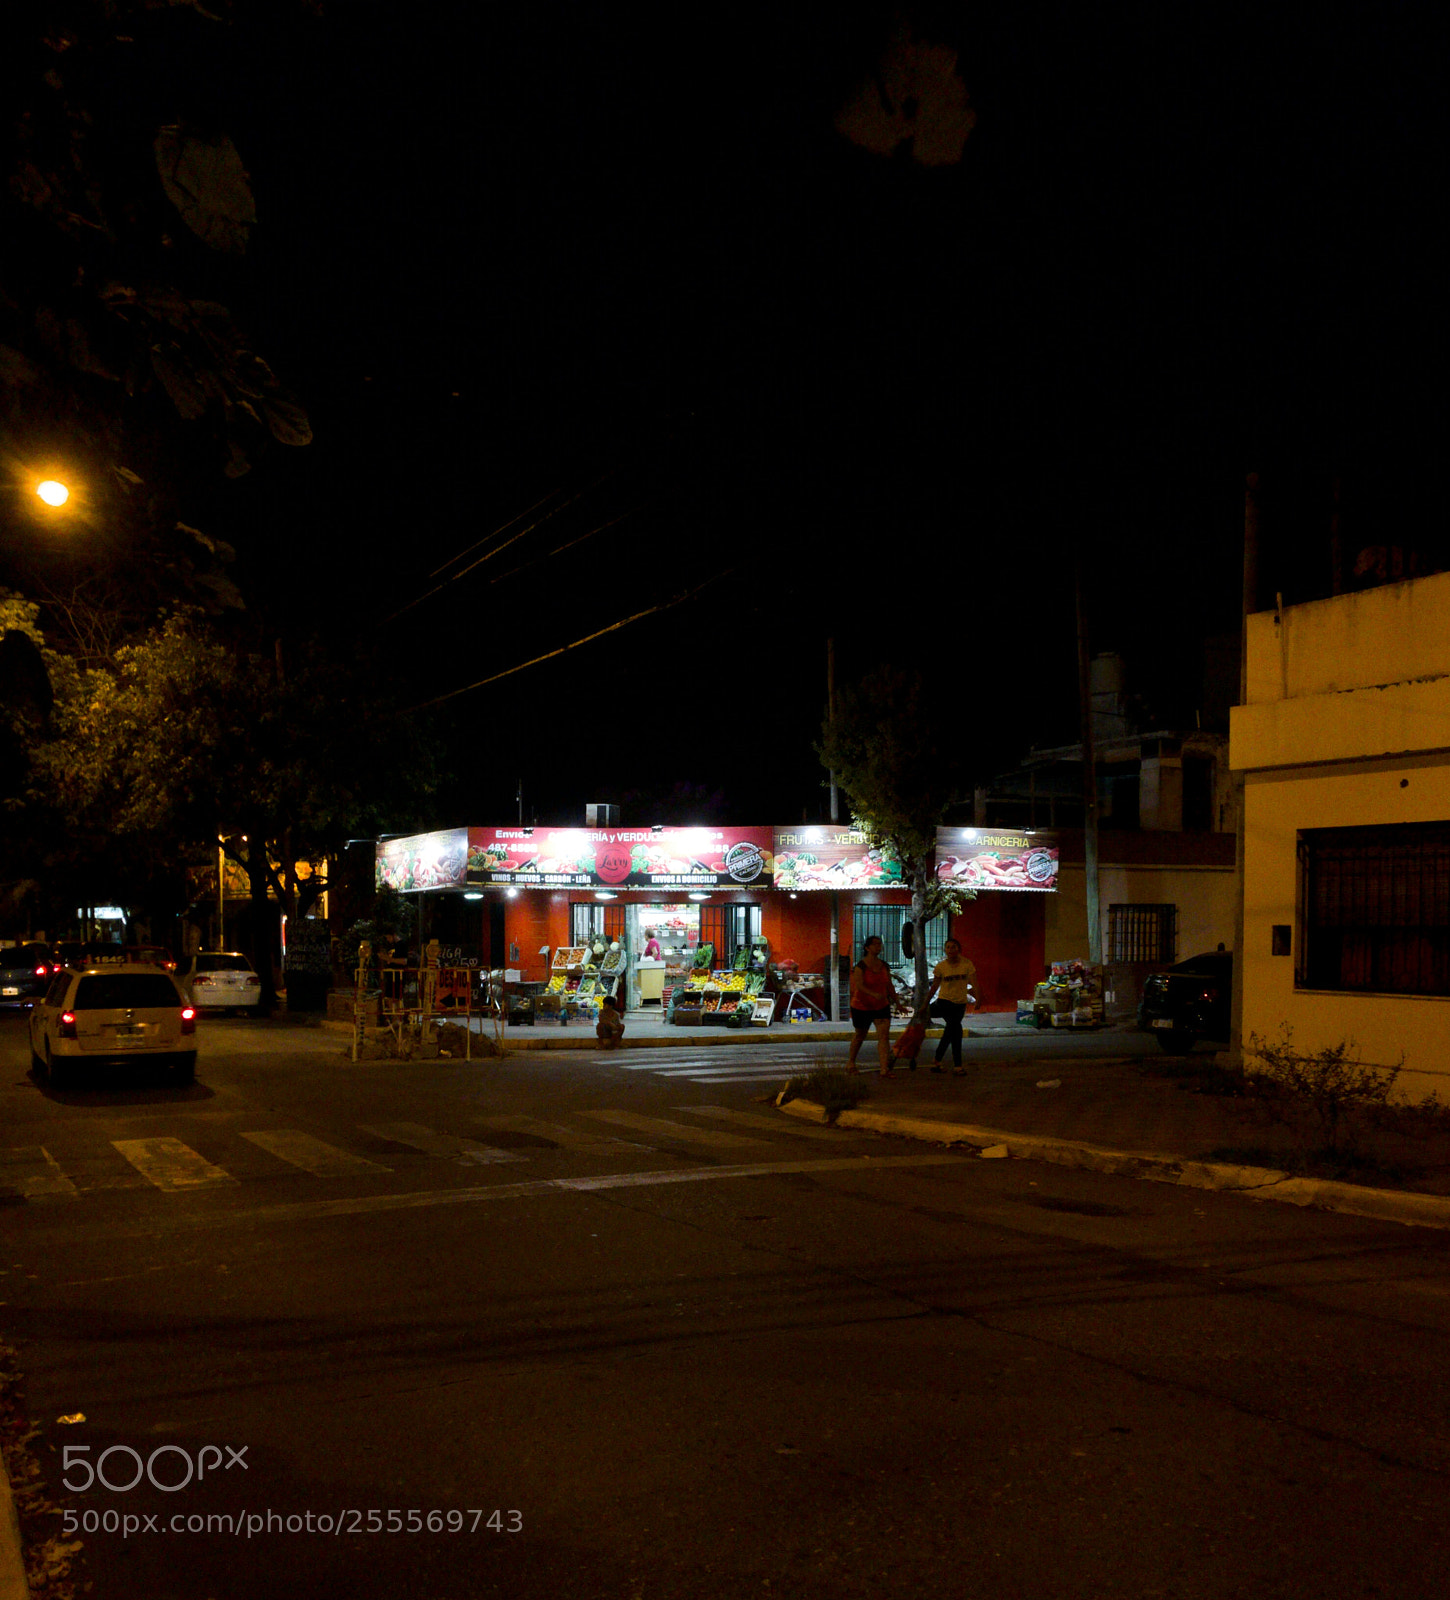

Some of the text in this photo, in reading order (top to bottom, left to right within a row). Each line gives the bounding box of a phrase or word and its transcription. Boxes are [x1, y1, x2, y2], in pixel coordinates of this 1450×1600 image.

[610, 834, 616, 843] y
[969, 835, 1030, 848] CARNICERIA
[728, 853, 762, 873] PRIMERA
[491, 873, 511, 882] VINOS
[515, 874, 540, 883] HUEVOS
[575, 874, 591, 883] LEÑA
[675, 874, 680, 884] A
[681, 874, 718, 884] DOMICILIO
